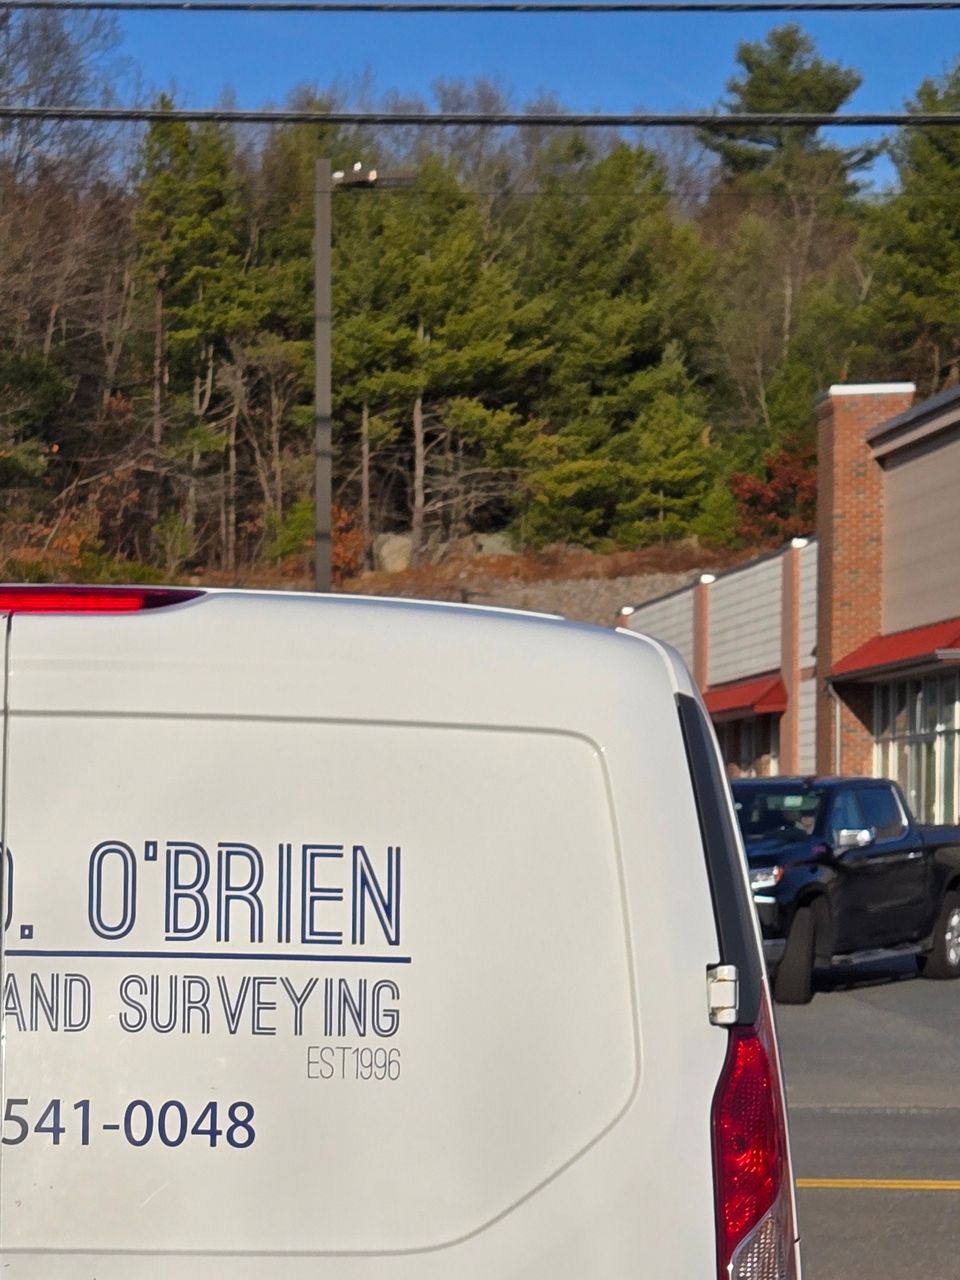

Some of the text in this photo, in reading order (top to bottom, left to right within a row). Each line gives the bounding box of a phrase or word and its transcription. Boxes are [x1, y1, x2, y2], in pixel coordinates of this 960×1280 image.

[88, 840, 402, 946] O'BRIEN
[118, 974, 402, 1038] SURVEYING
[306, 1045, 402, 1081] EST1996
